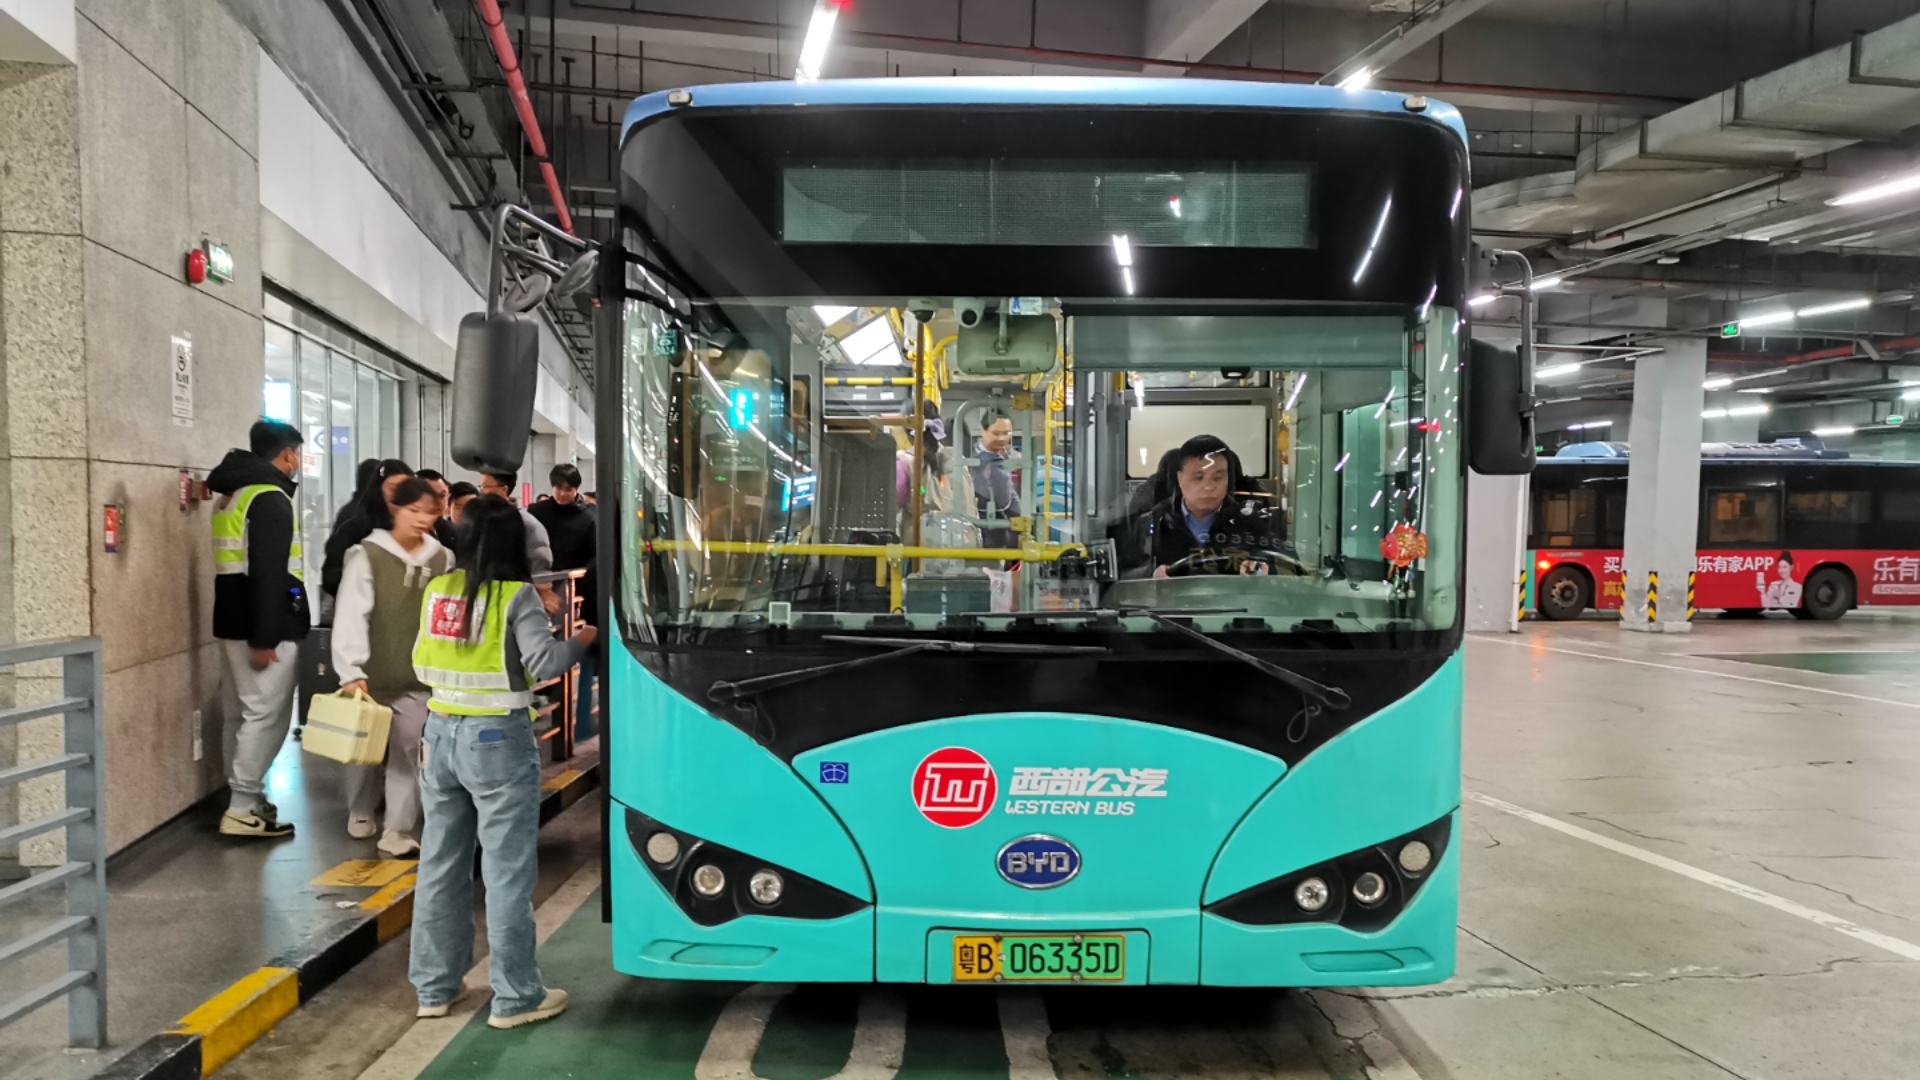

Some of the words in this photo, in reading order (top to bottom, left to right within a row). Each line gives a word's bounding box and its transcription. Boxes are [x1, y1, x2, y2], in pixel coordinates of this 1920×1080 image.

[1603, 556, 1624, 573] 买
[1695, 555, 1774, 573] 乐有家APP
[1008, 766, 1169, 797] 西部公汽
[1004, 799, 1090, 816] WESTERN
[1094, 800, 1136, 816] BUS
[1006, 851, 1071, 873] BYD
